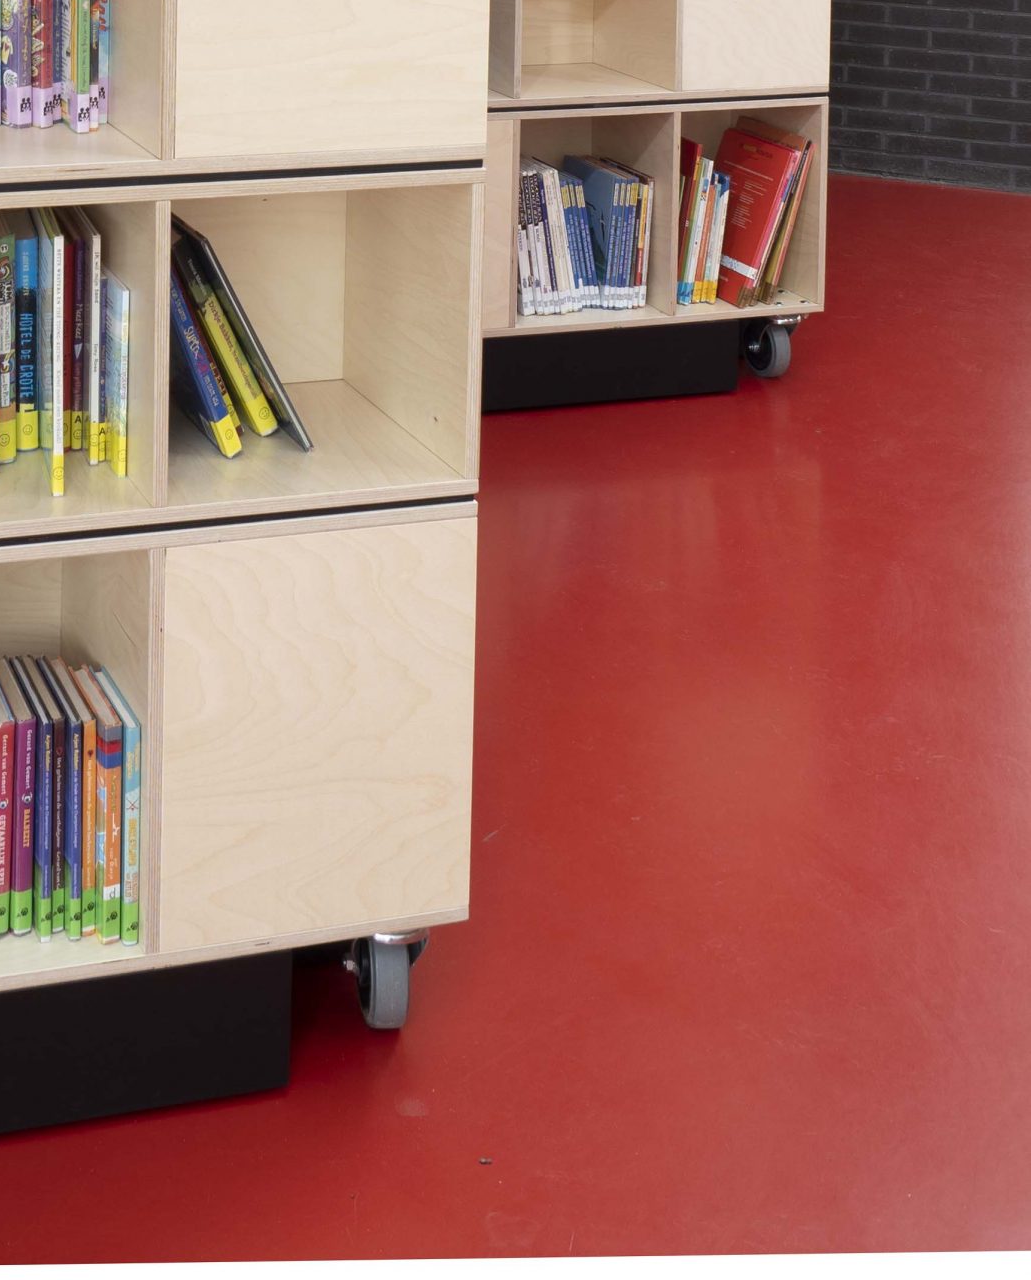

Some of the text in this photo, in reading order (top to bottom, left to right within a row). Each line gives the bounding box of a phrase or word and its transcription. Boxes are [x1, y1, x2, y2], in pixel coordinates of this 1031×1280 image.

[20, 313, 34, 345] HOTEL
[75, 304, 83, 339] Mees Kees
[21, 349, 30, 360] DE
[20, 365, 34, 398] GROTE
[23, 808, 31, 847] BALBEZIT
